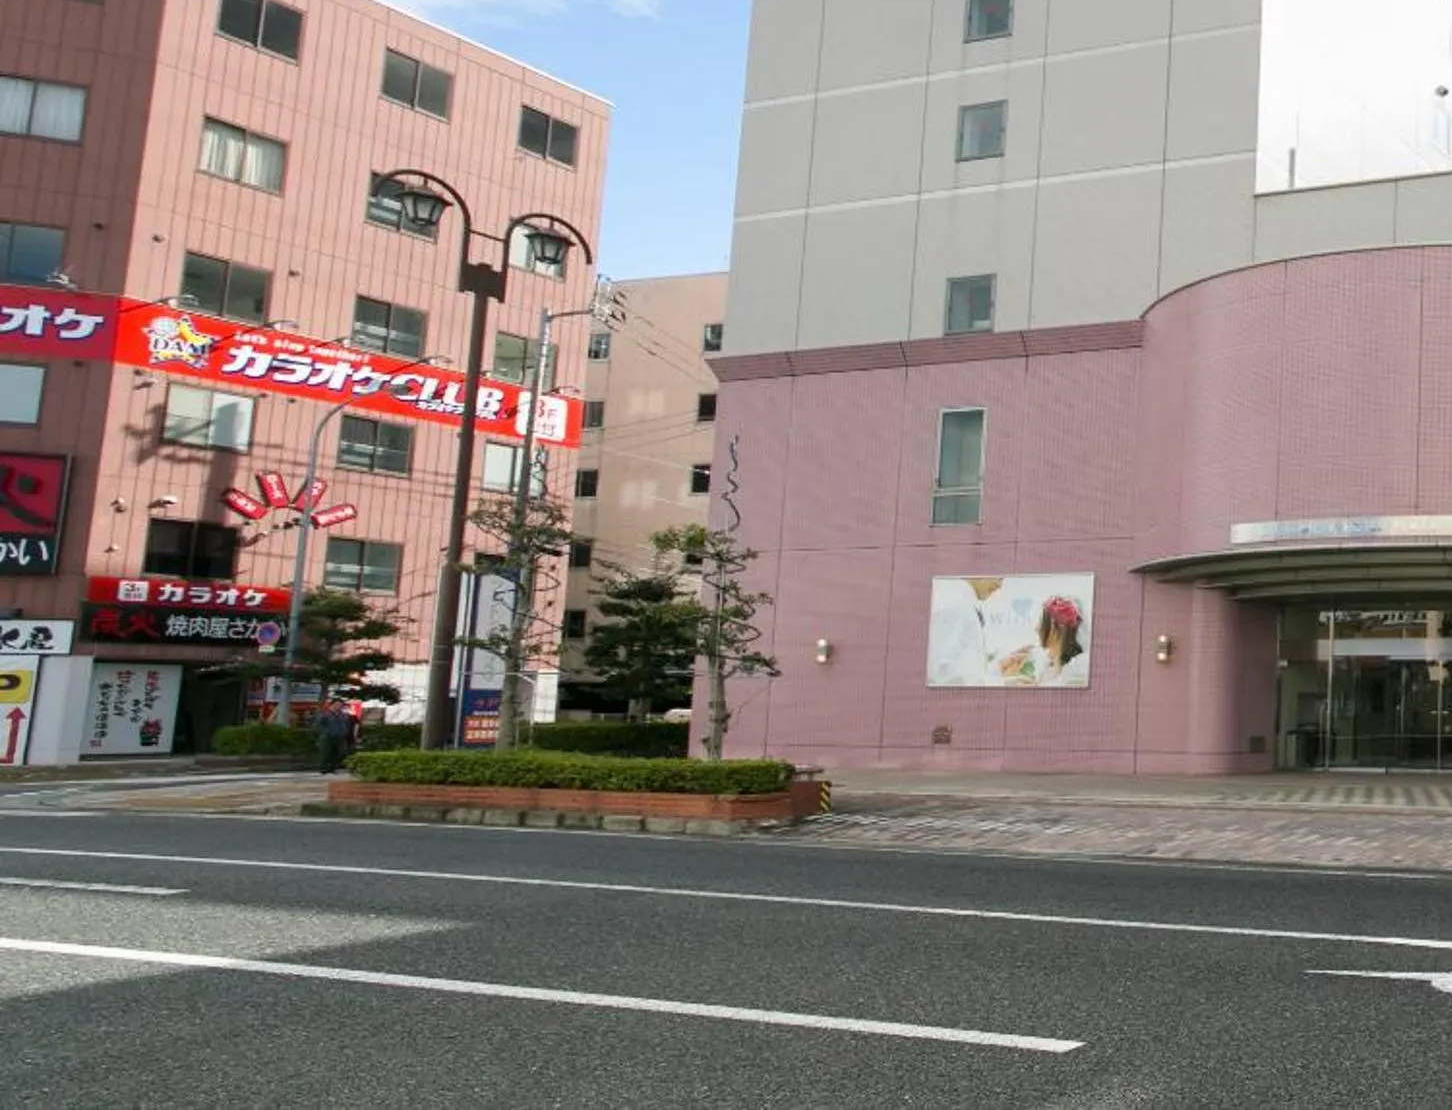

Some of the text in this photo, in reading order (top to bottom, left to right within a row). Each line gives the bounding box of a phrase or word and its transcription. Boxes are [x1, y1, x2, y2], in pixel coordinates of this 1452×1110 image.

[0, 303, 104, 339] オケ
[152, 336, 212, 356] DAM
[157, 583, 268, 606] カラオケ
